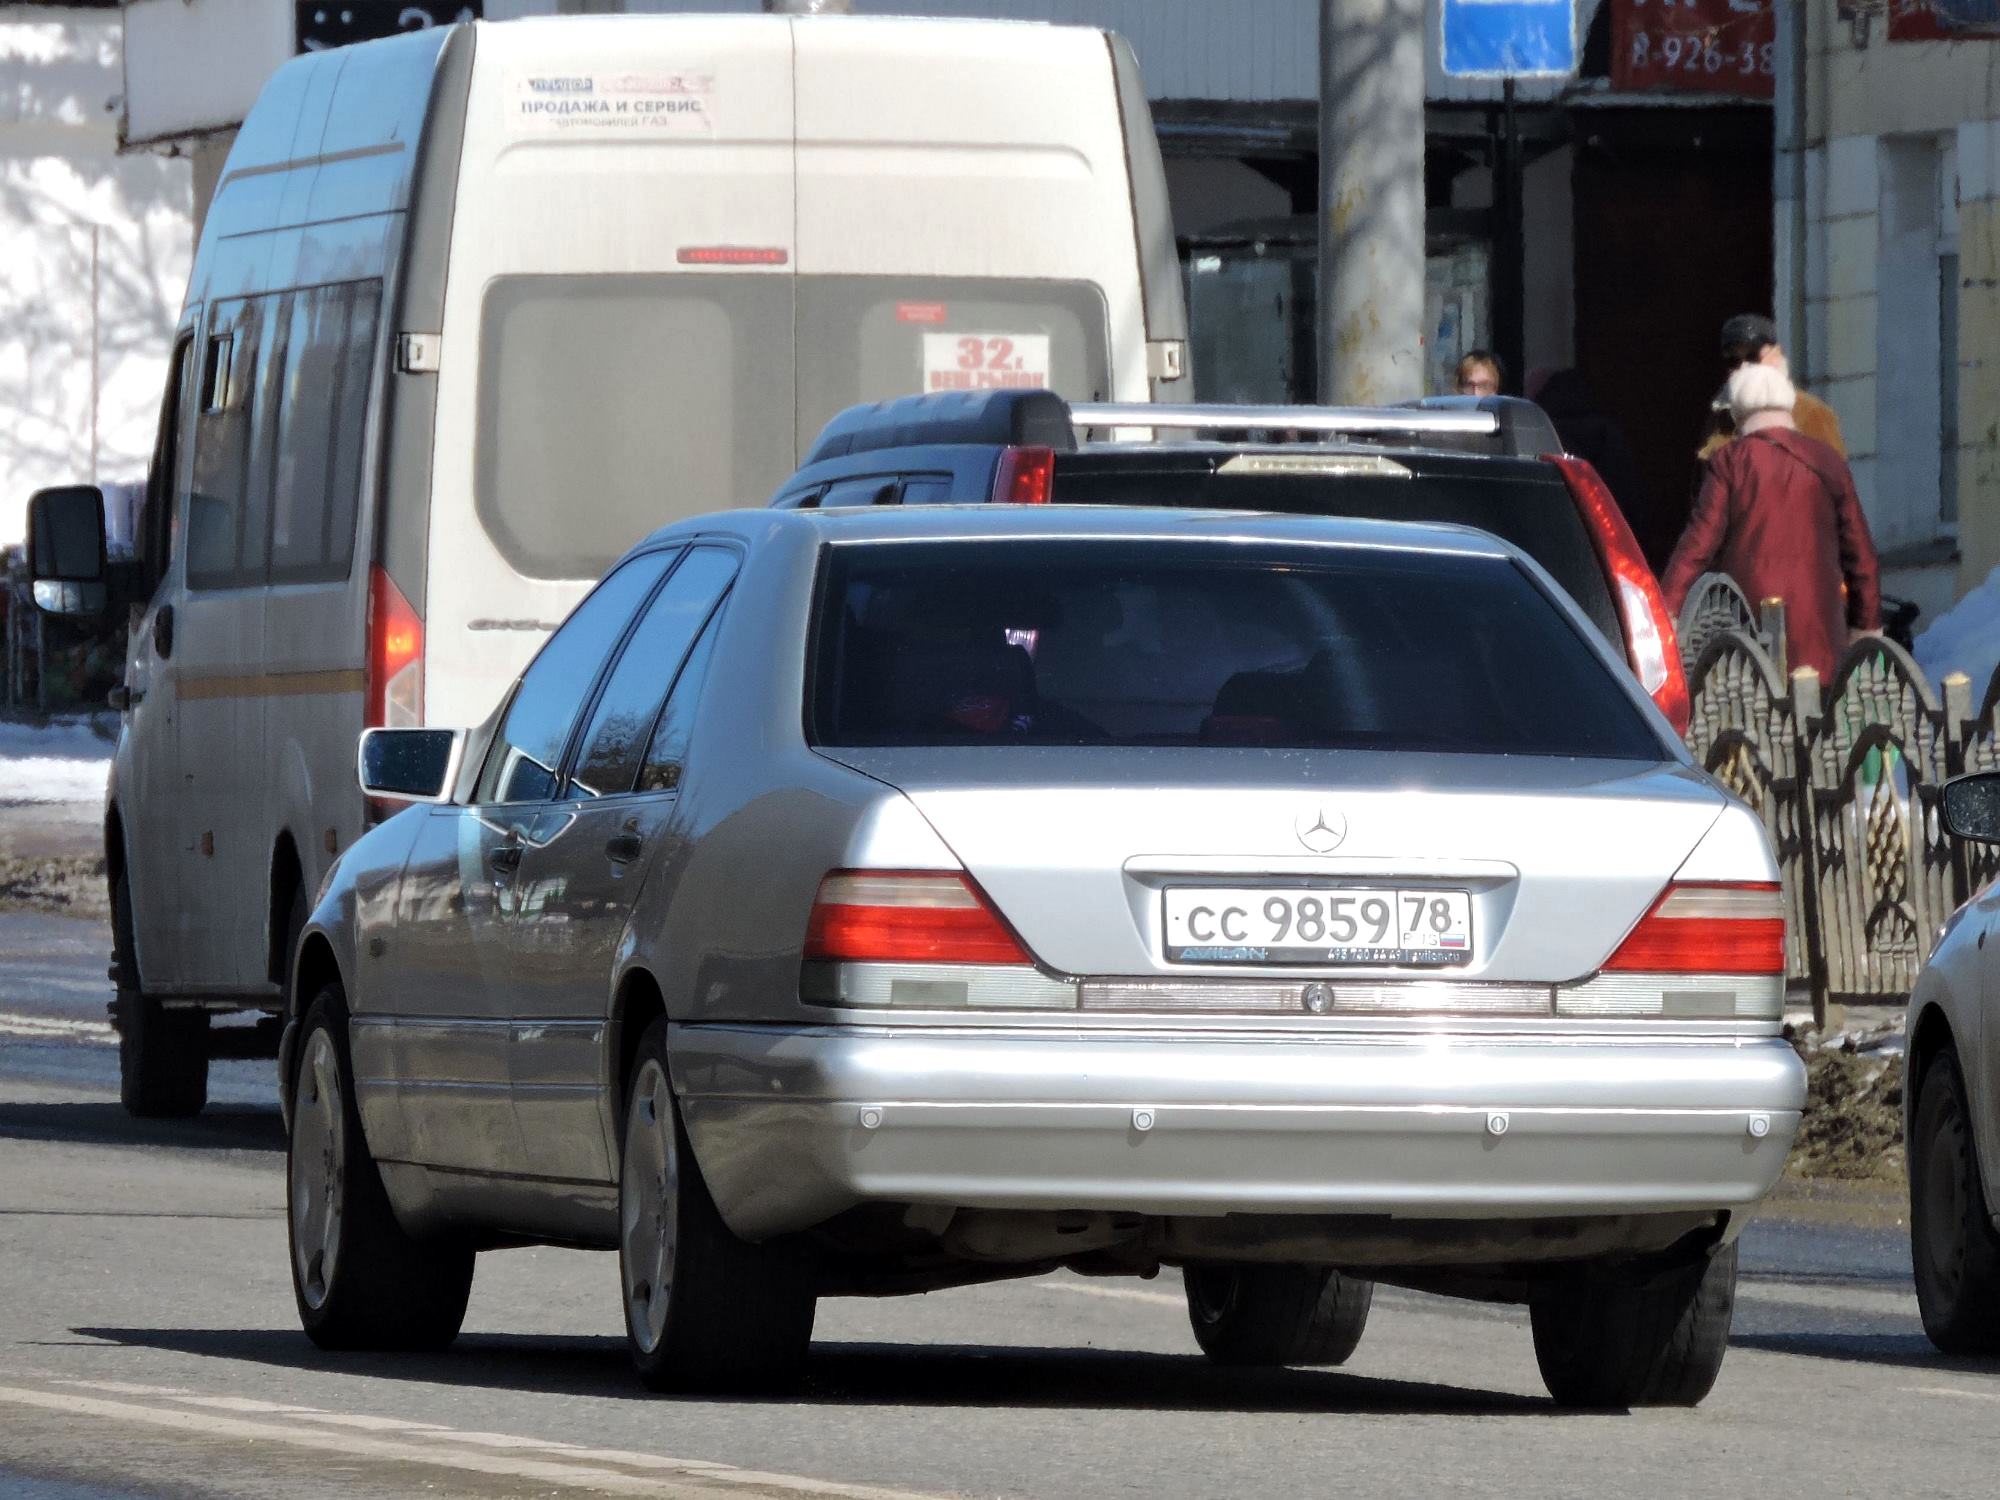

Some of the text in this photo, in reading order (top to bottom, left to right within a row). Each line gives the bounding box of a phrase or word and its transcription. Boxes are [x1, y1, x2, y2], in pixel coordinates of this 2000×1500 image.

[521, 100, 702, 115] ПРОДАЖА И СЕРВИС
[642, 115, 668, 127] ГАЗ
[1262, 896, 1391, 944] 9859
[1403, 896, 1453, 933] 78
[1180, 947, 1266, 960] AVILON
